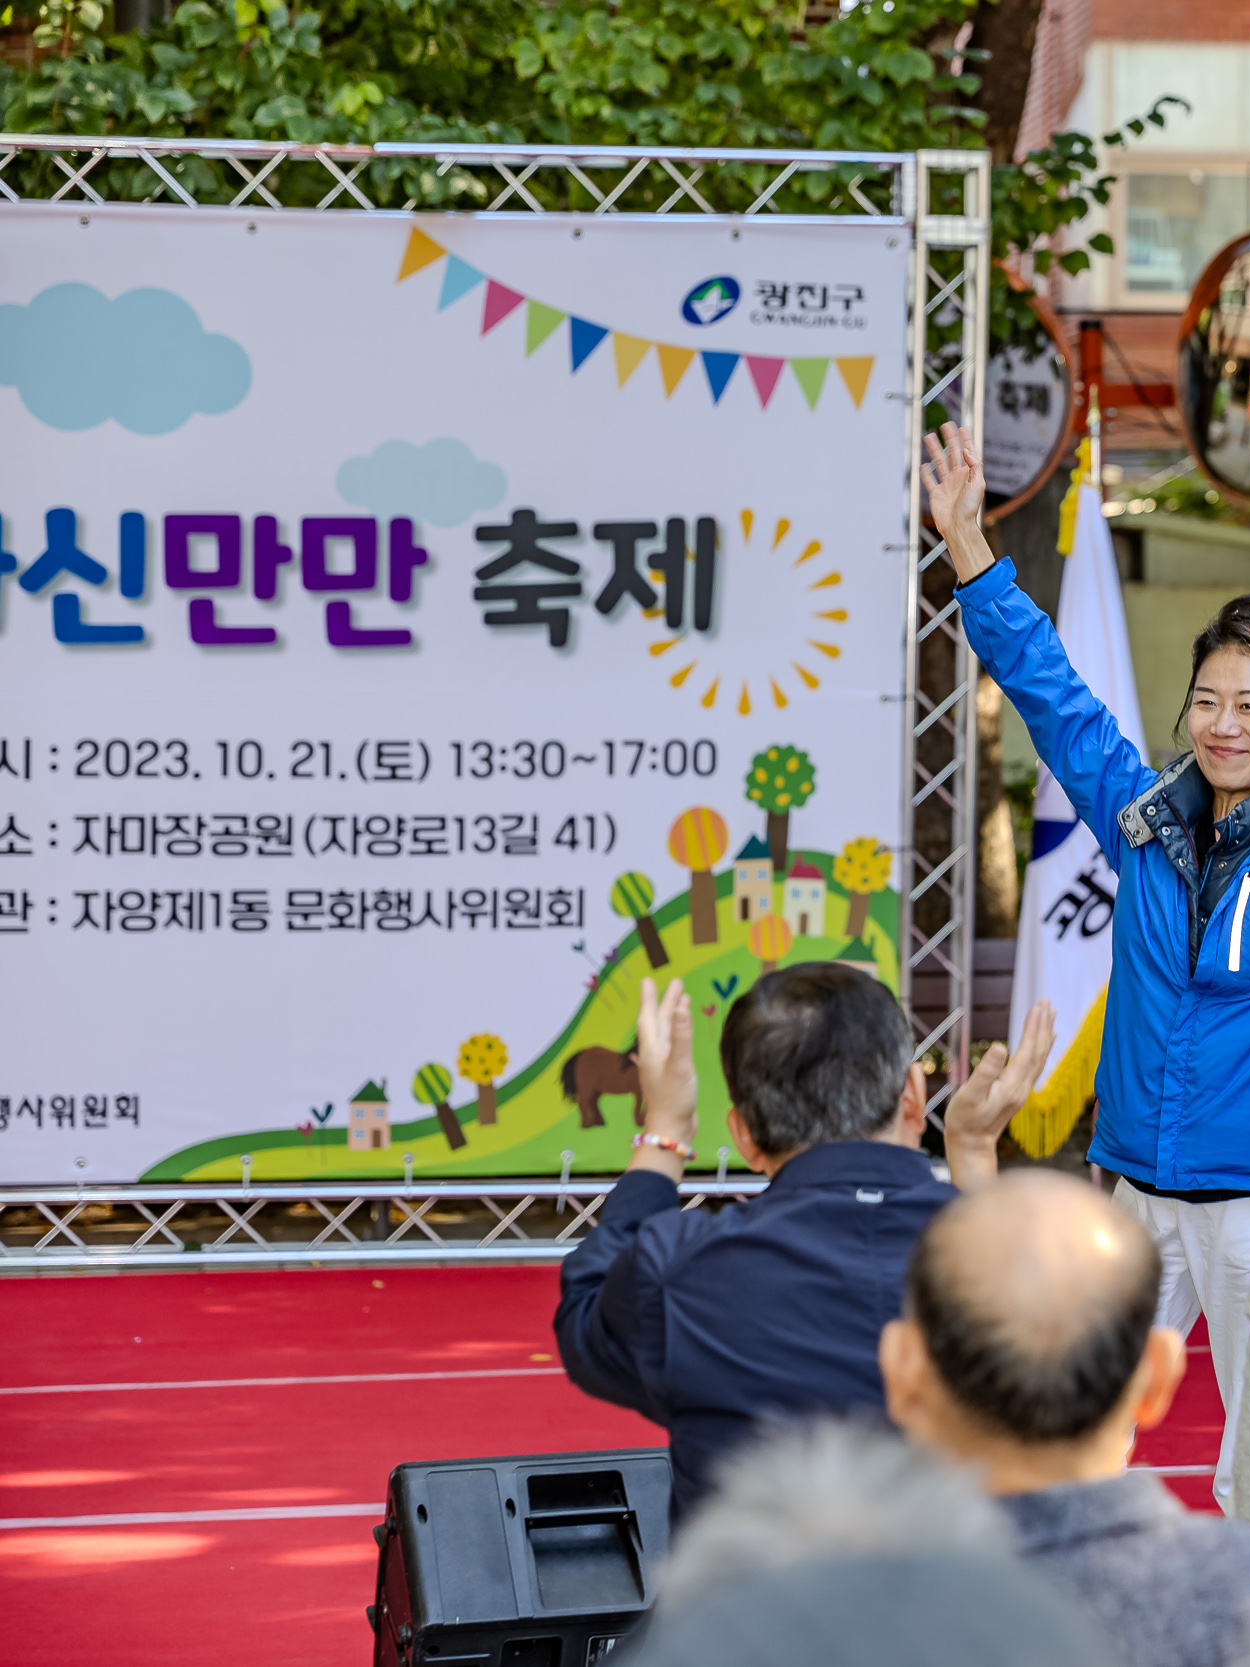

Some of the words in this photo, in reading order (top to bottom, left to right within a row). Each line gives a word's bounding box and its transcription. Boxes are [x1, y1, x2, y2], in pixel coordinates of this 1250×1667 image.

[754, 278, 865, 312] 광진구
[0, 508, 427, 646] 신만만
[474, 509, 716, 648] 축제
[75, 739, 200, 779] 2023.
[216, 740, 275, 779] 10.
[450, 738, 718, 780] 13:30~17:00
[553, 812, 618, 856] 41)
[72, 889, 269, 933] 자양제1동
[284, 887, 584, 932] 문화행사위원회
[1043, 849, 1116, 939] 광
